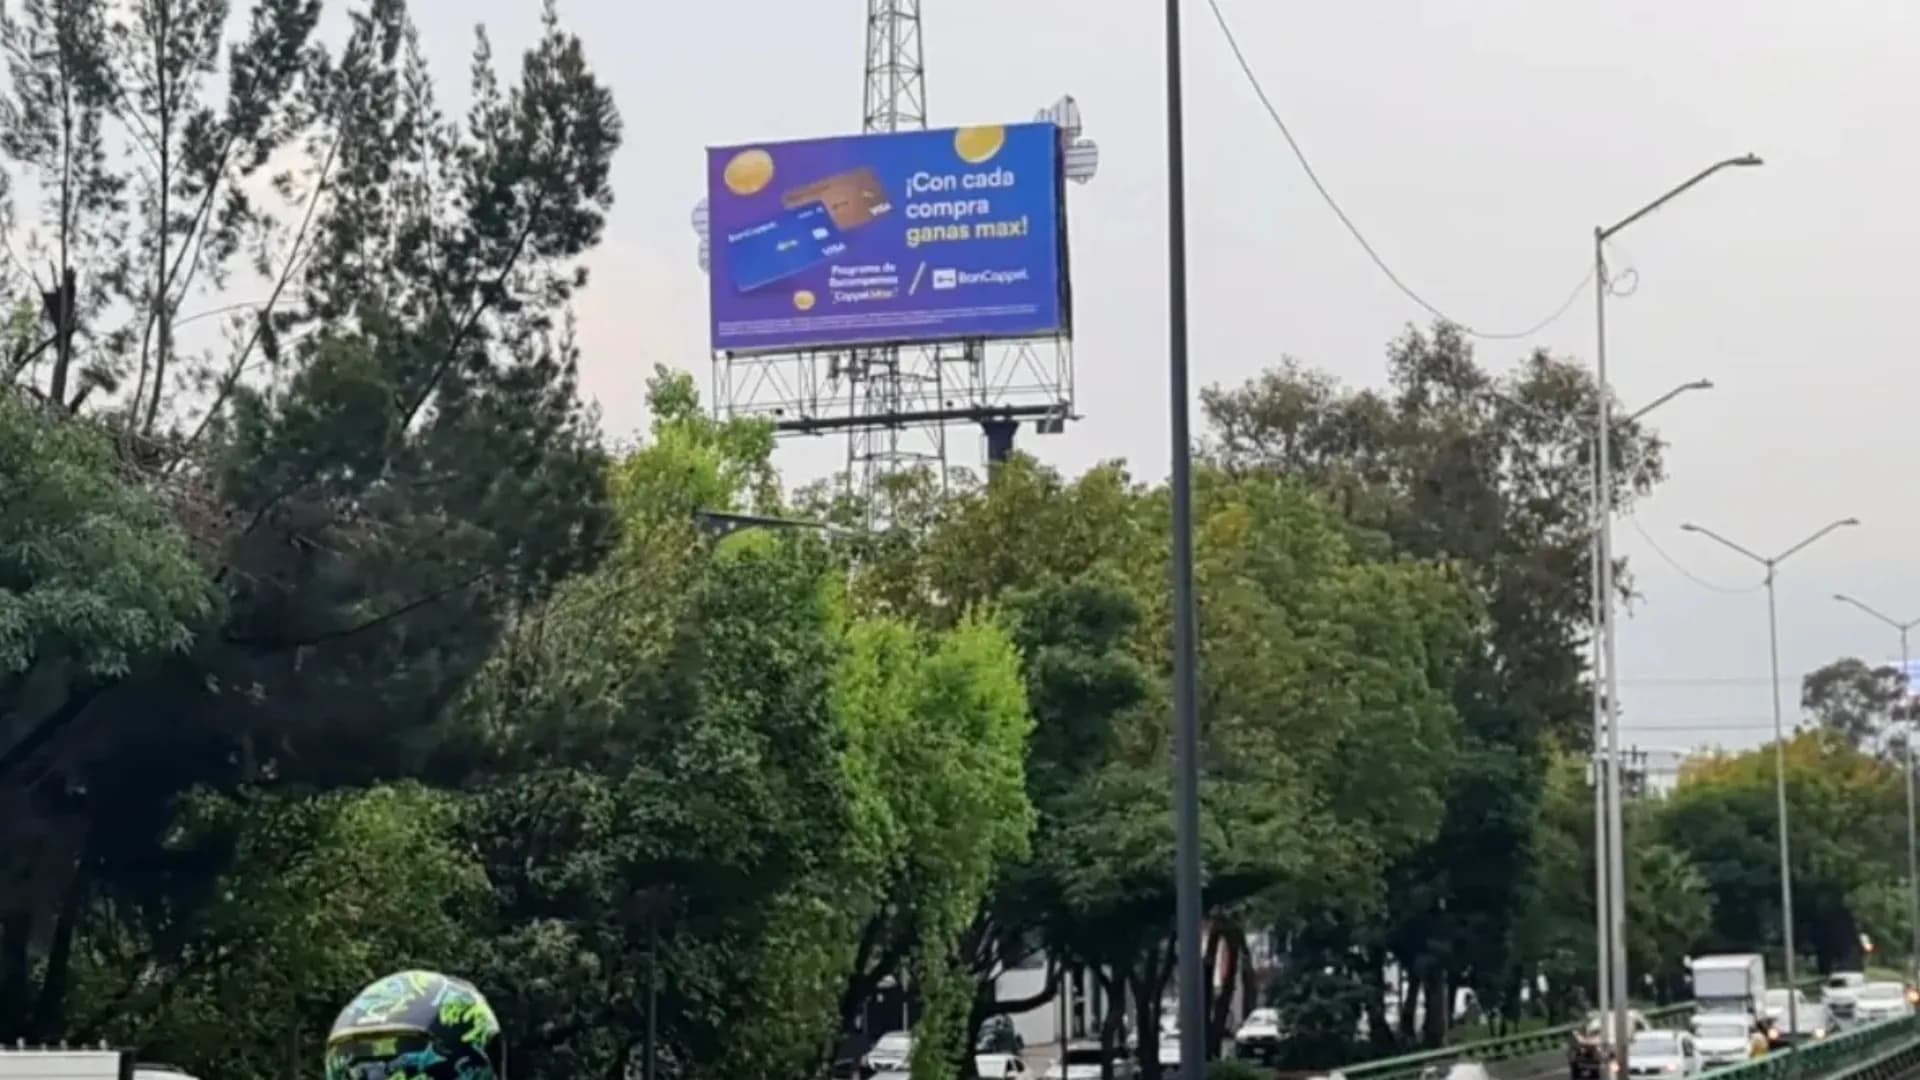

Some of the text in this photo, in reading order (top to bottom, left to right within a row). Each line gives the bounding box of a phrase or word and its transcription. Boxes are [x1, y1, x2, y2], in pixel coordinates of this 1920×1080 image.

[906, 166, 1015, 199] ¡Con cada
[905, 199, 989, 220] compra
[906, 215, 1028, 248] ganas max!
